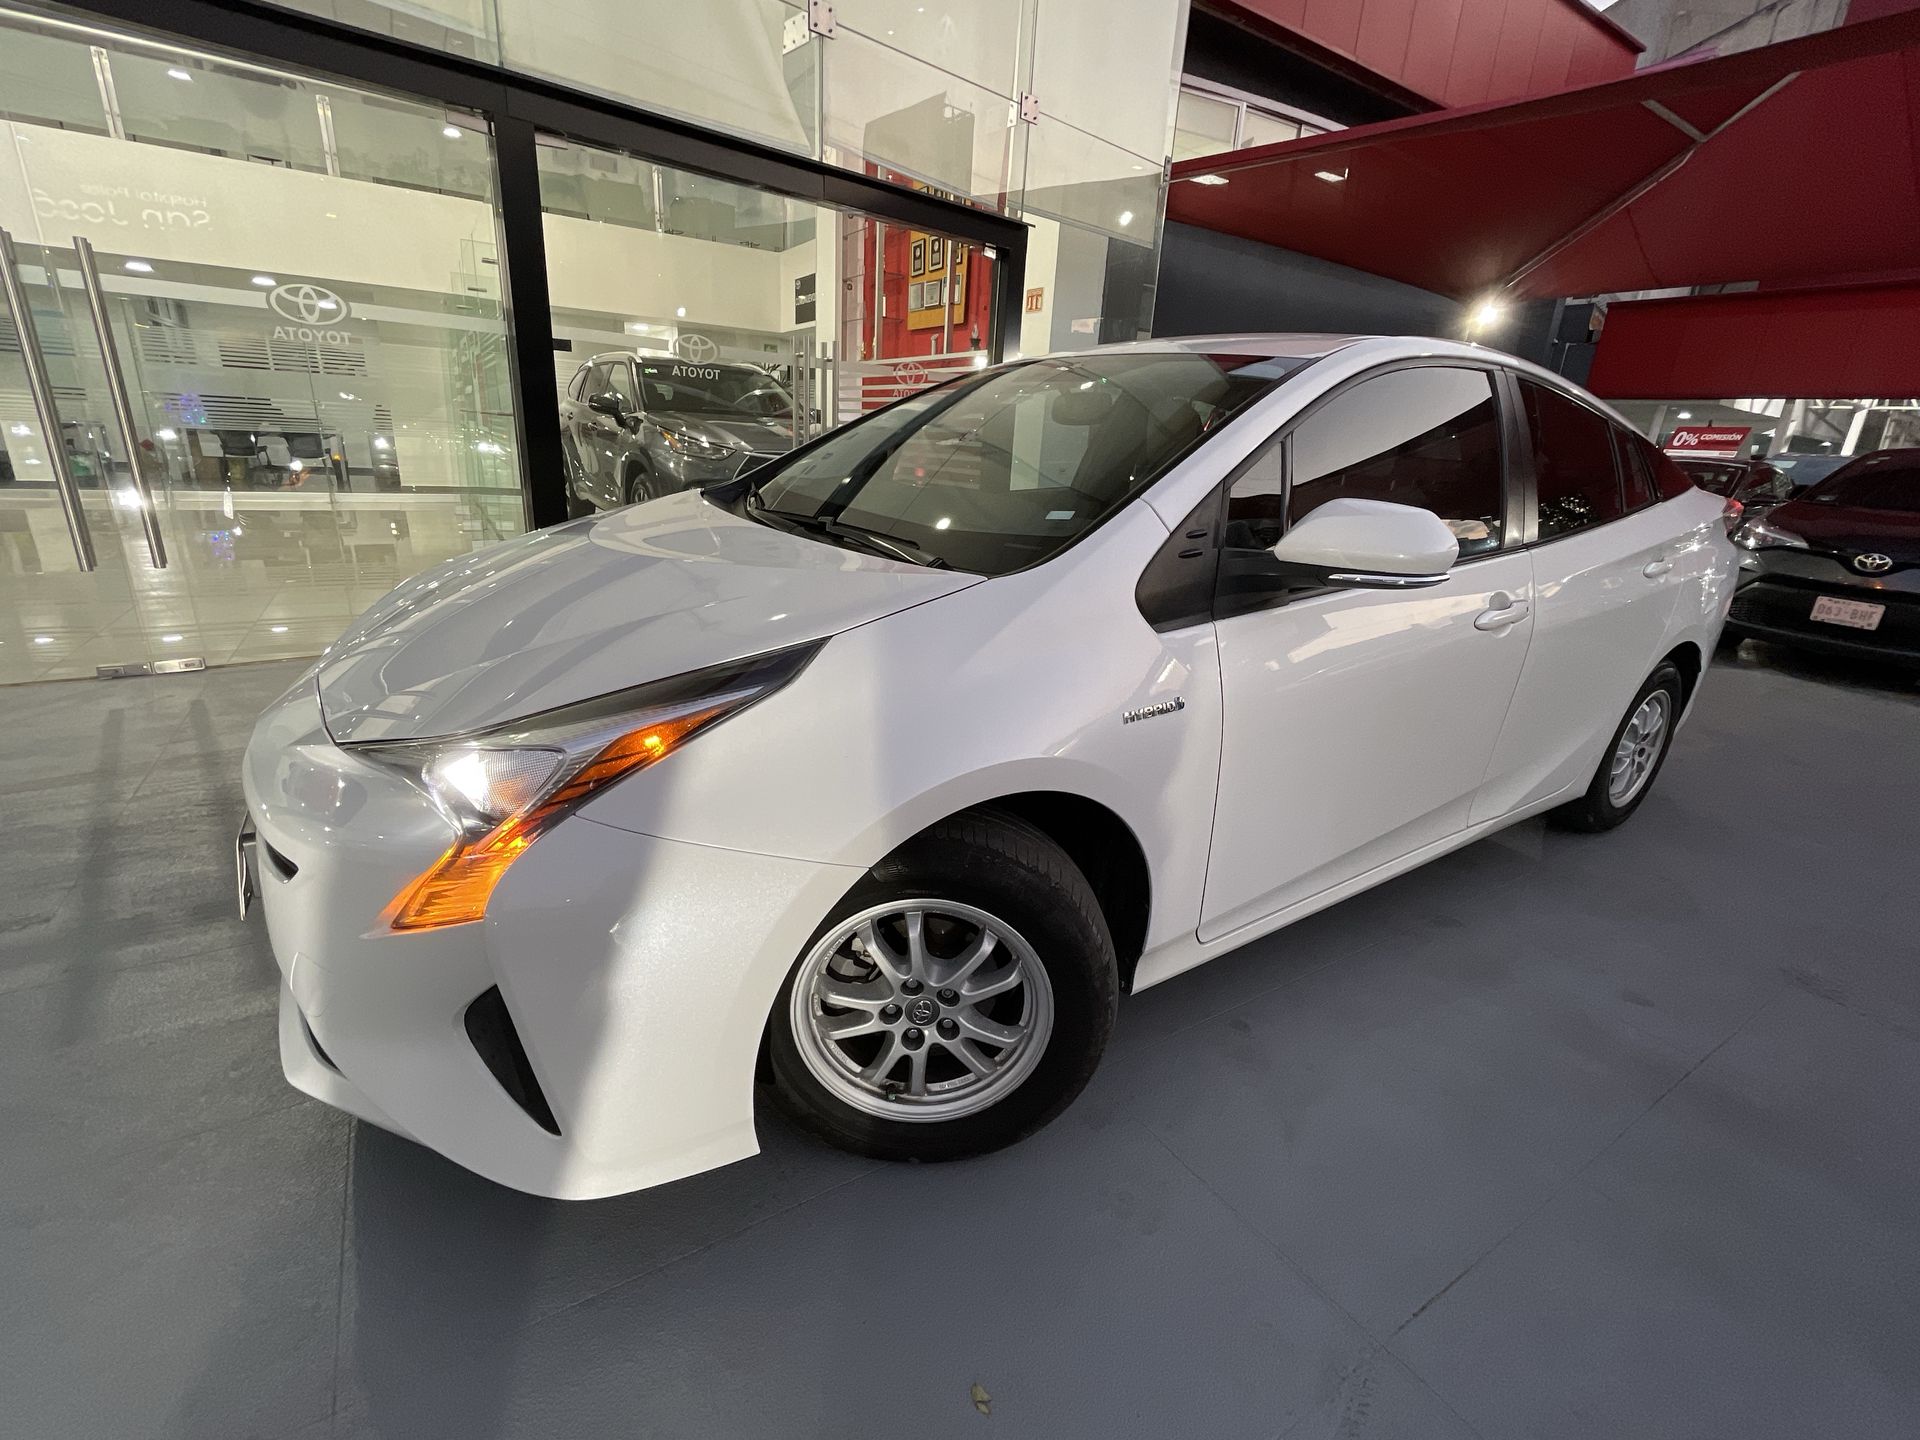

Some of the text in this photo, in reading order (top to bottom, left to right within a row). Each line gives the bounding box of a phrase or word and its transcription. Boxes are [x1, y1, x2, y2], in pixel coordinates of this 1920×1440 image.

[1672, 431, 1744, 447] 0% COMISIÓN
[1122, 701, 1176, 724] HYBRID
